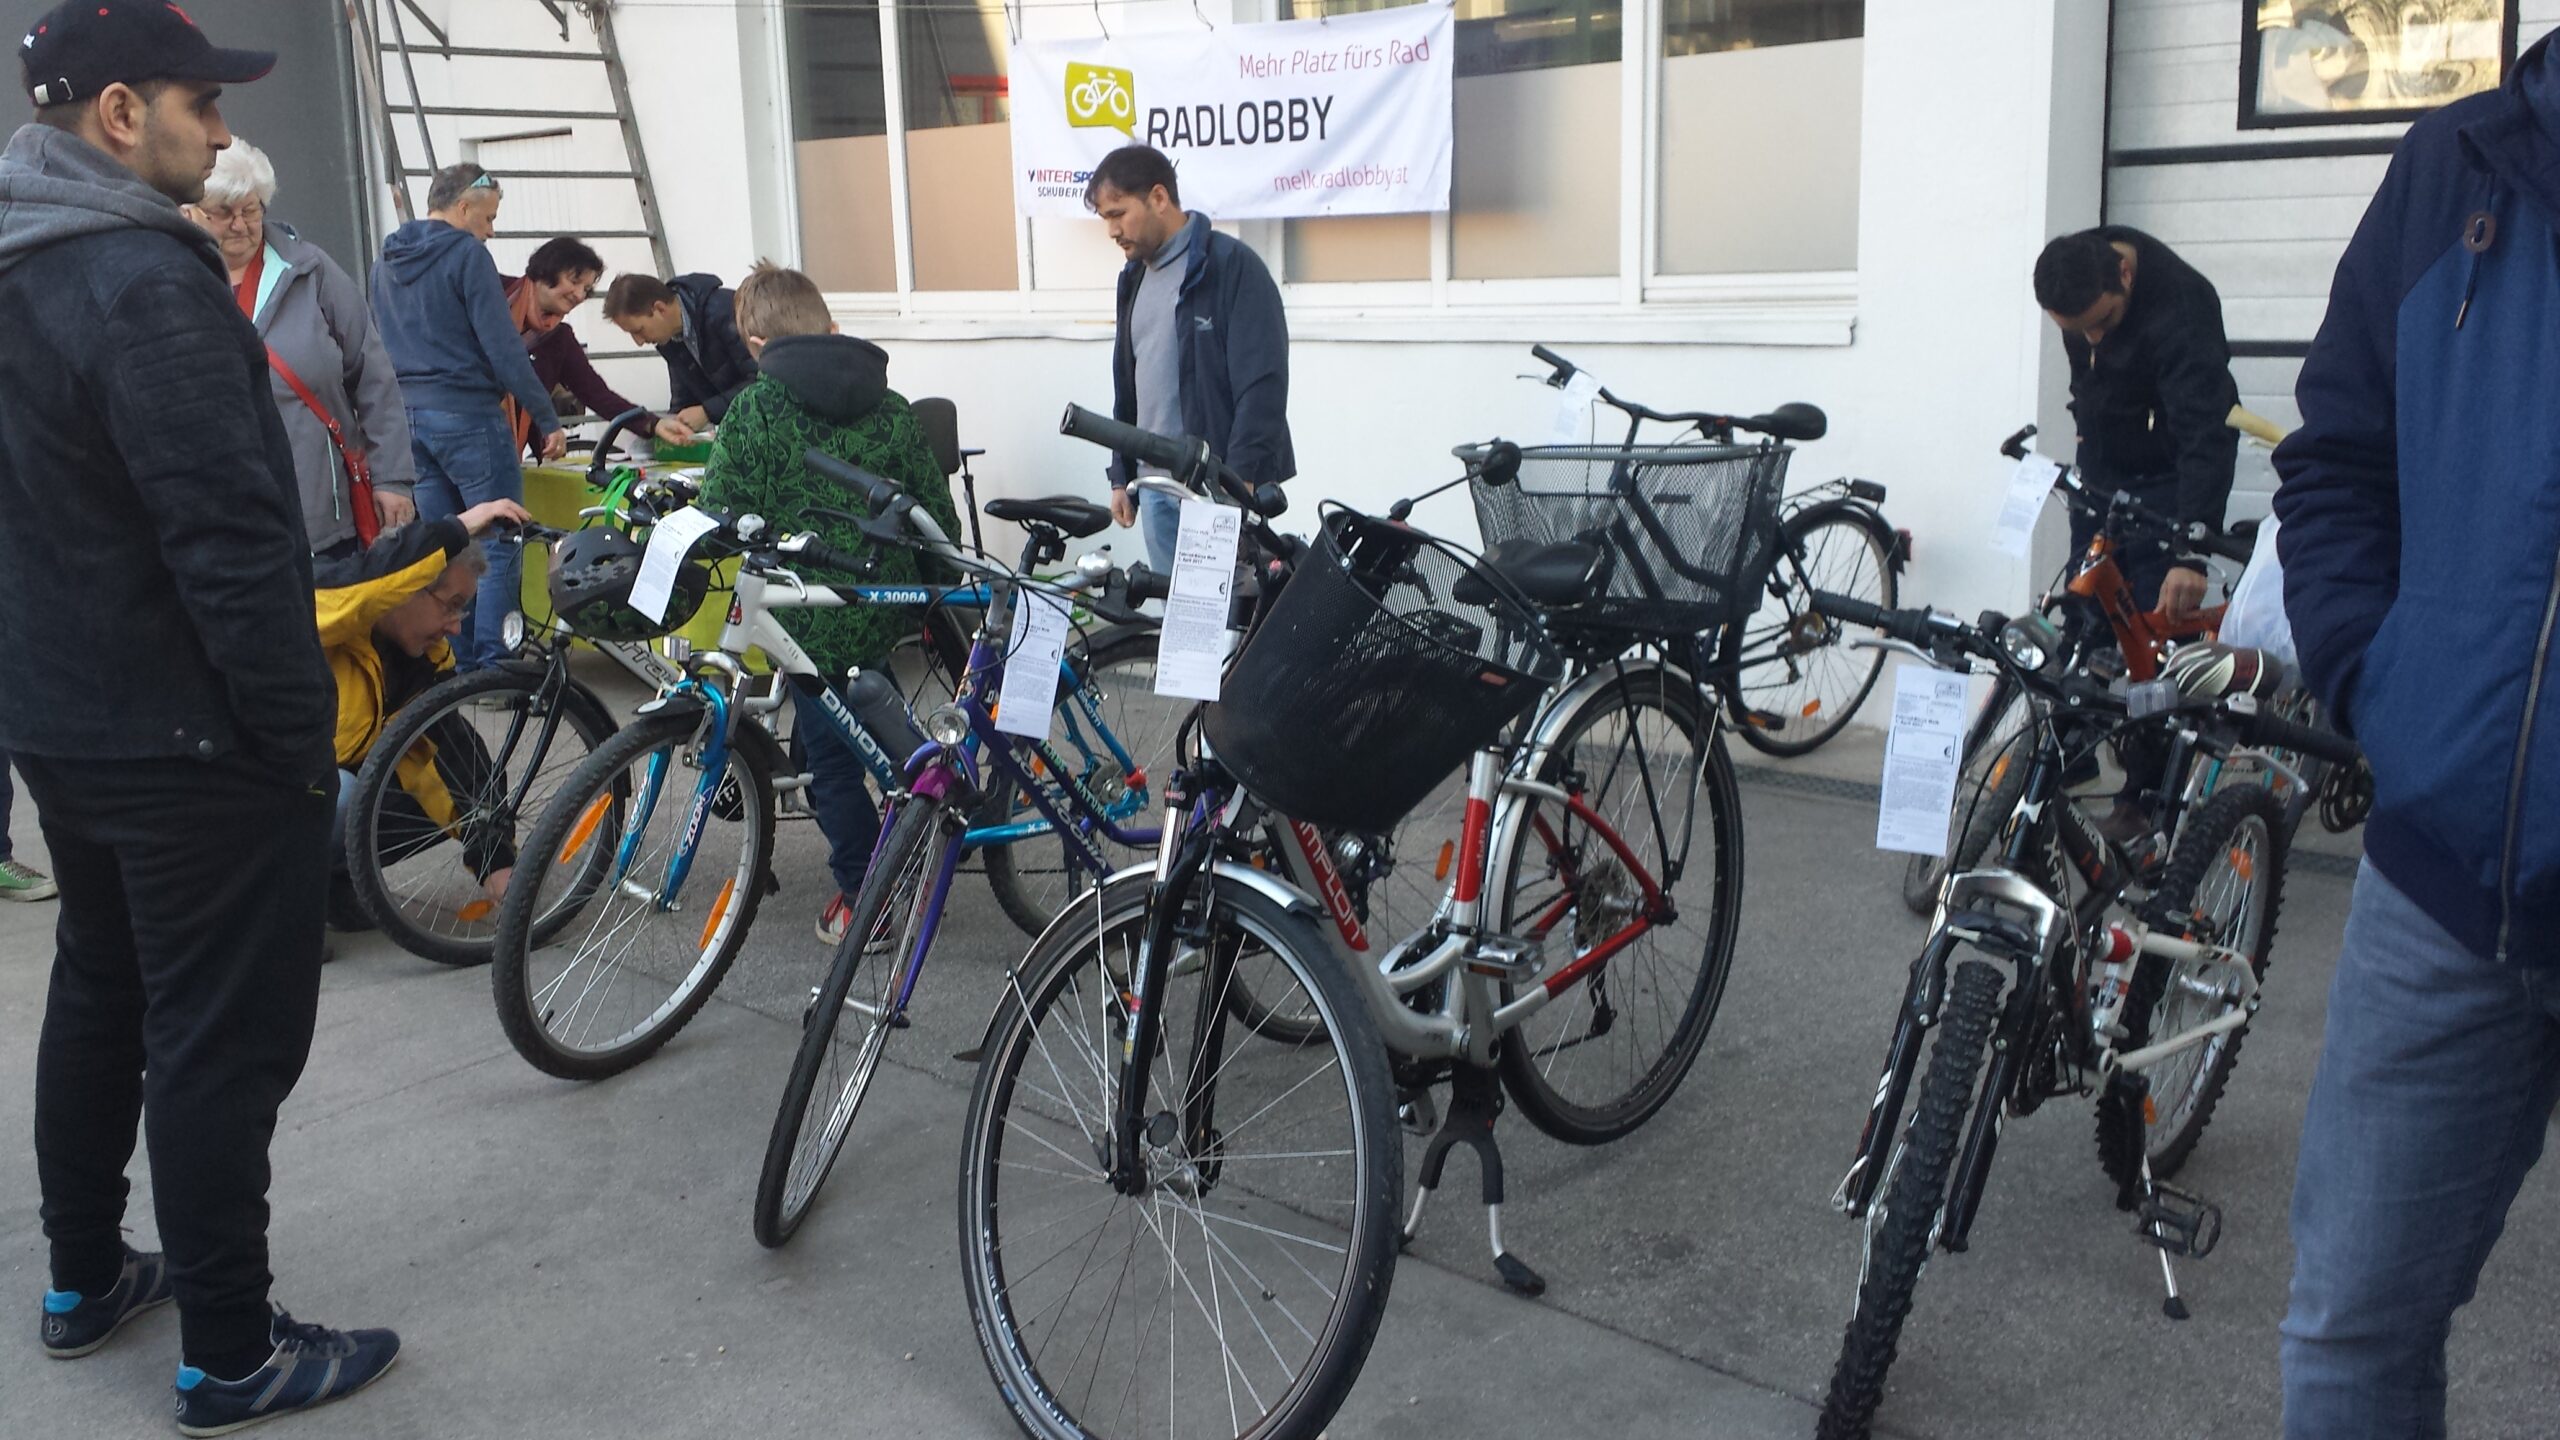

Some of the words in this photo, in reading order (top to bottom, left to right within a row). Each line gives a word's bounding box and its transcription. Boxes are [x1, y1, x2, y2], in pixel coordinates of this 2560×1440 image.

[1240, 52, 1286, 79] Mehr
[1292, 50, 1338, 74] Platz
[1344, 44, 1382, 70] fürs
[1388, 36, 1430, 65] Rad
[1146, 95, 1334, 148] RADLOBBY
[1274, 164, 1408, 192] melk.radlobby.at
[868, 590, 880, 604] X
[820, 686, 893, 778] DINOT
[684, 794, 706, 848] ZOOM
